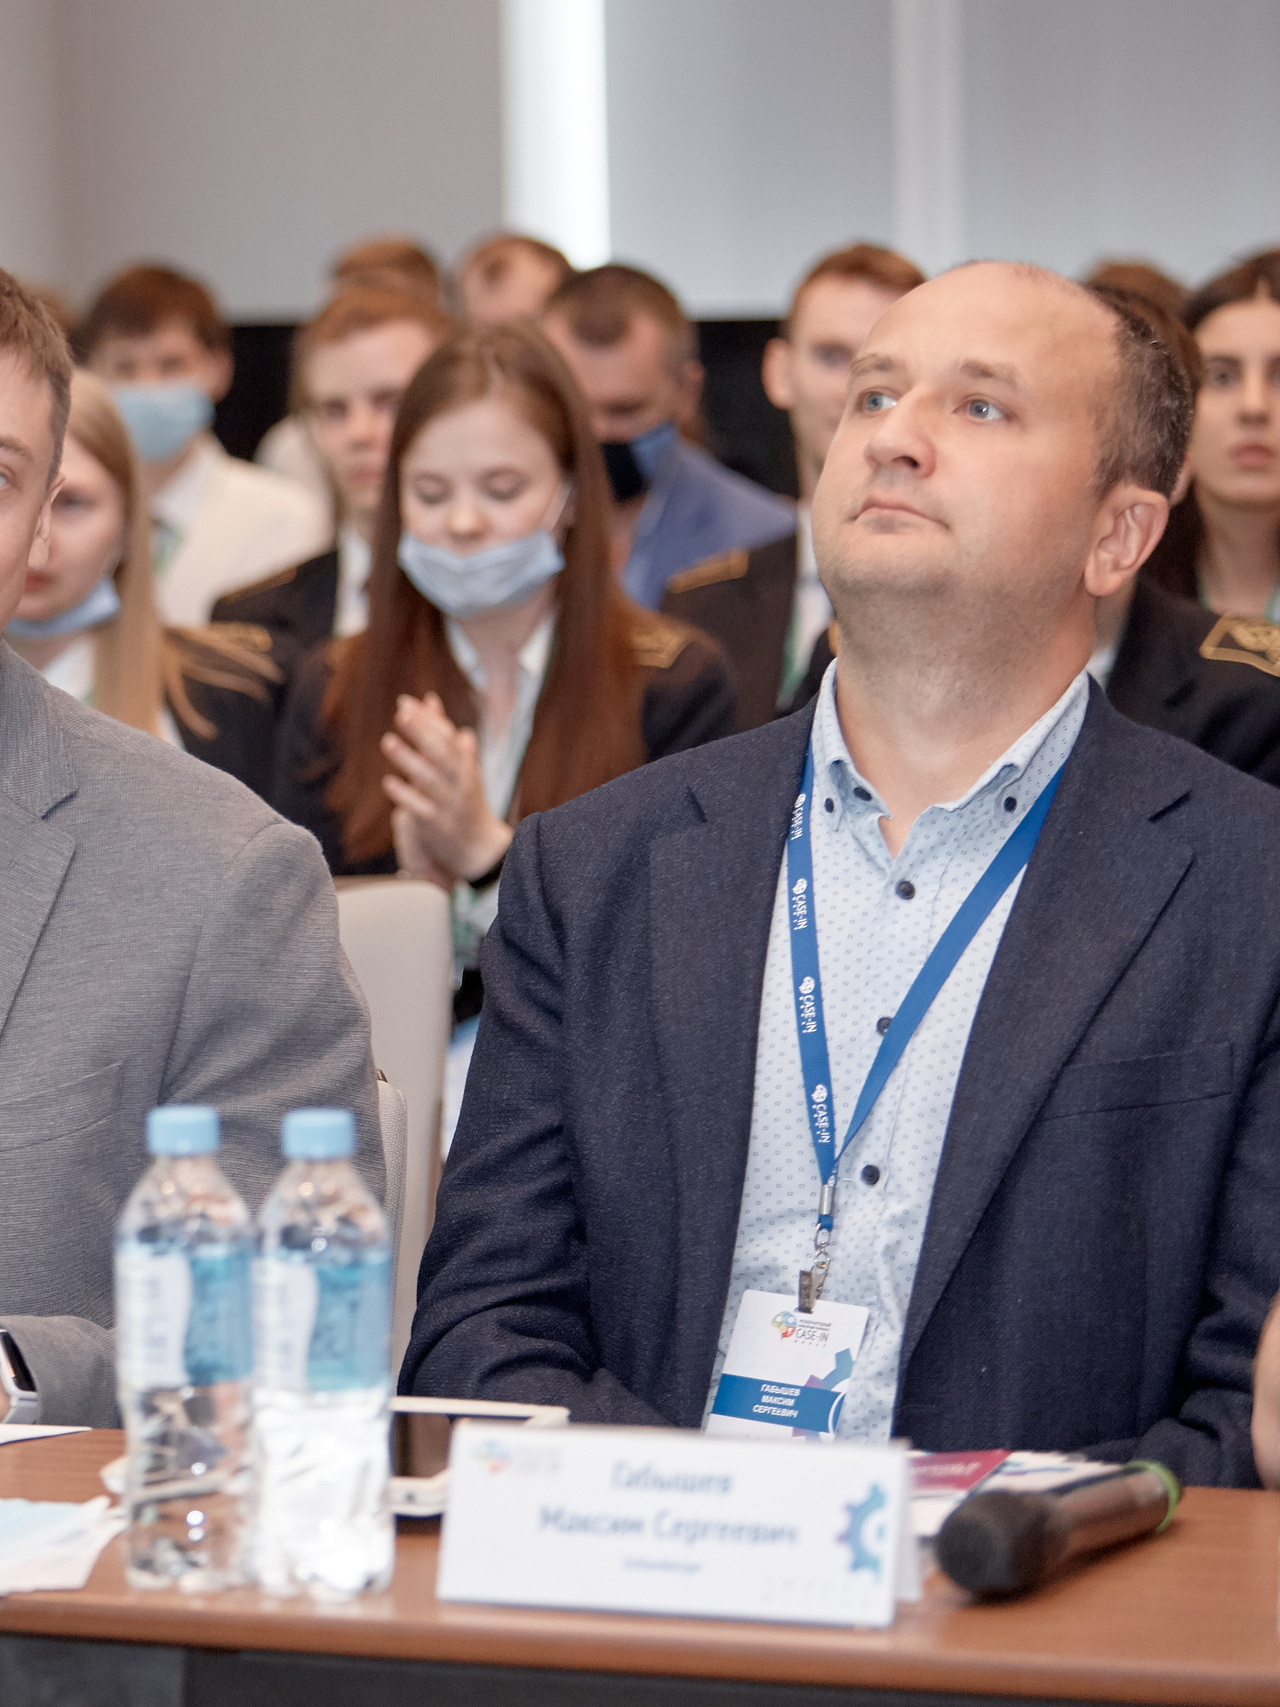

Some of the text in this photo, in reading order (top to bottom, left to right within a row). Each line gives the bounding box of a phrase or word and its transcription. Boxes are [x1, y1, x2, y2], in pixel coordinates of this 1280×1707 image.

[795, 894, 808, 930] CASE-IN
[803, 994, 818, 1033] CASE-IN
[816, 1103, 831, 1143] CASE-IN
[796, 1328, 829, 1342] CASE-IN
[760, 1383, 801, 1397] ГАБЫШЕВ
[761, 1394, 795, 1407] МАКСИМ
[752, 1404, 799, 1418] СЕРГЕЕВИЧ
[539, 1503, 644, 1537] Максим
